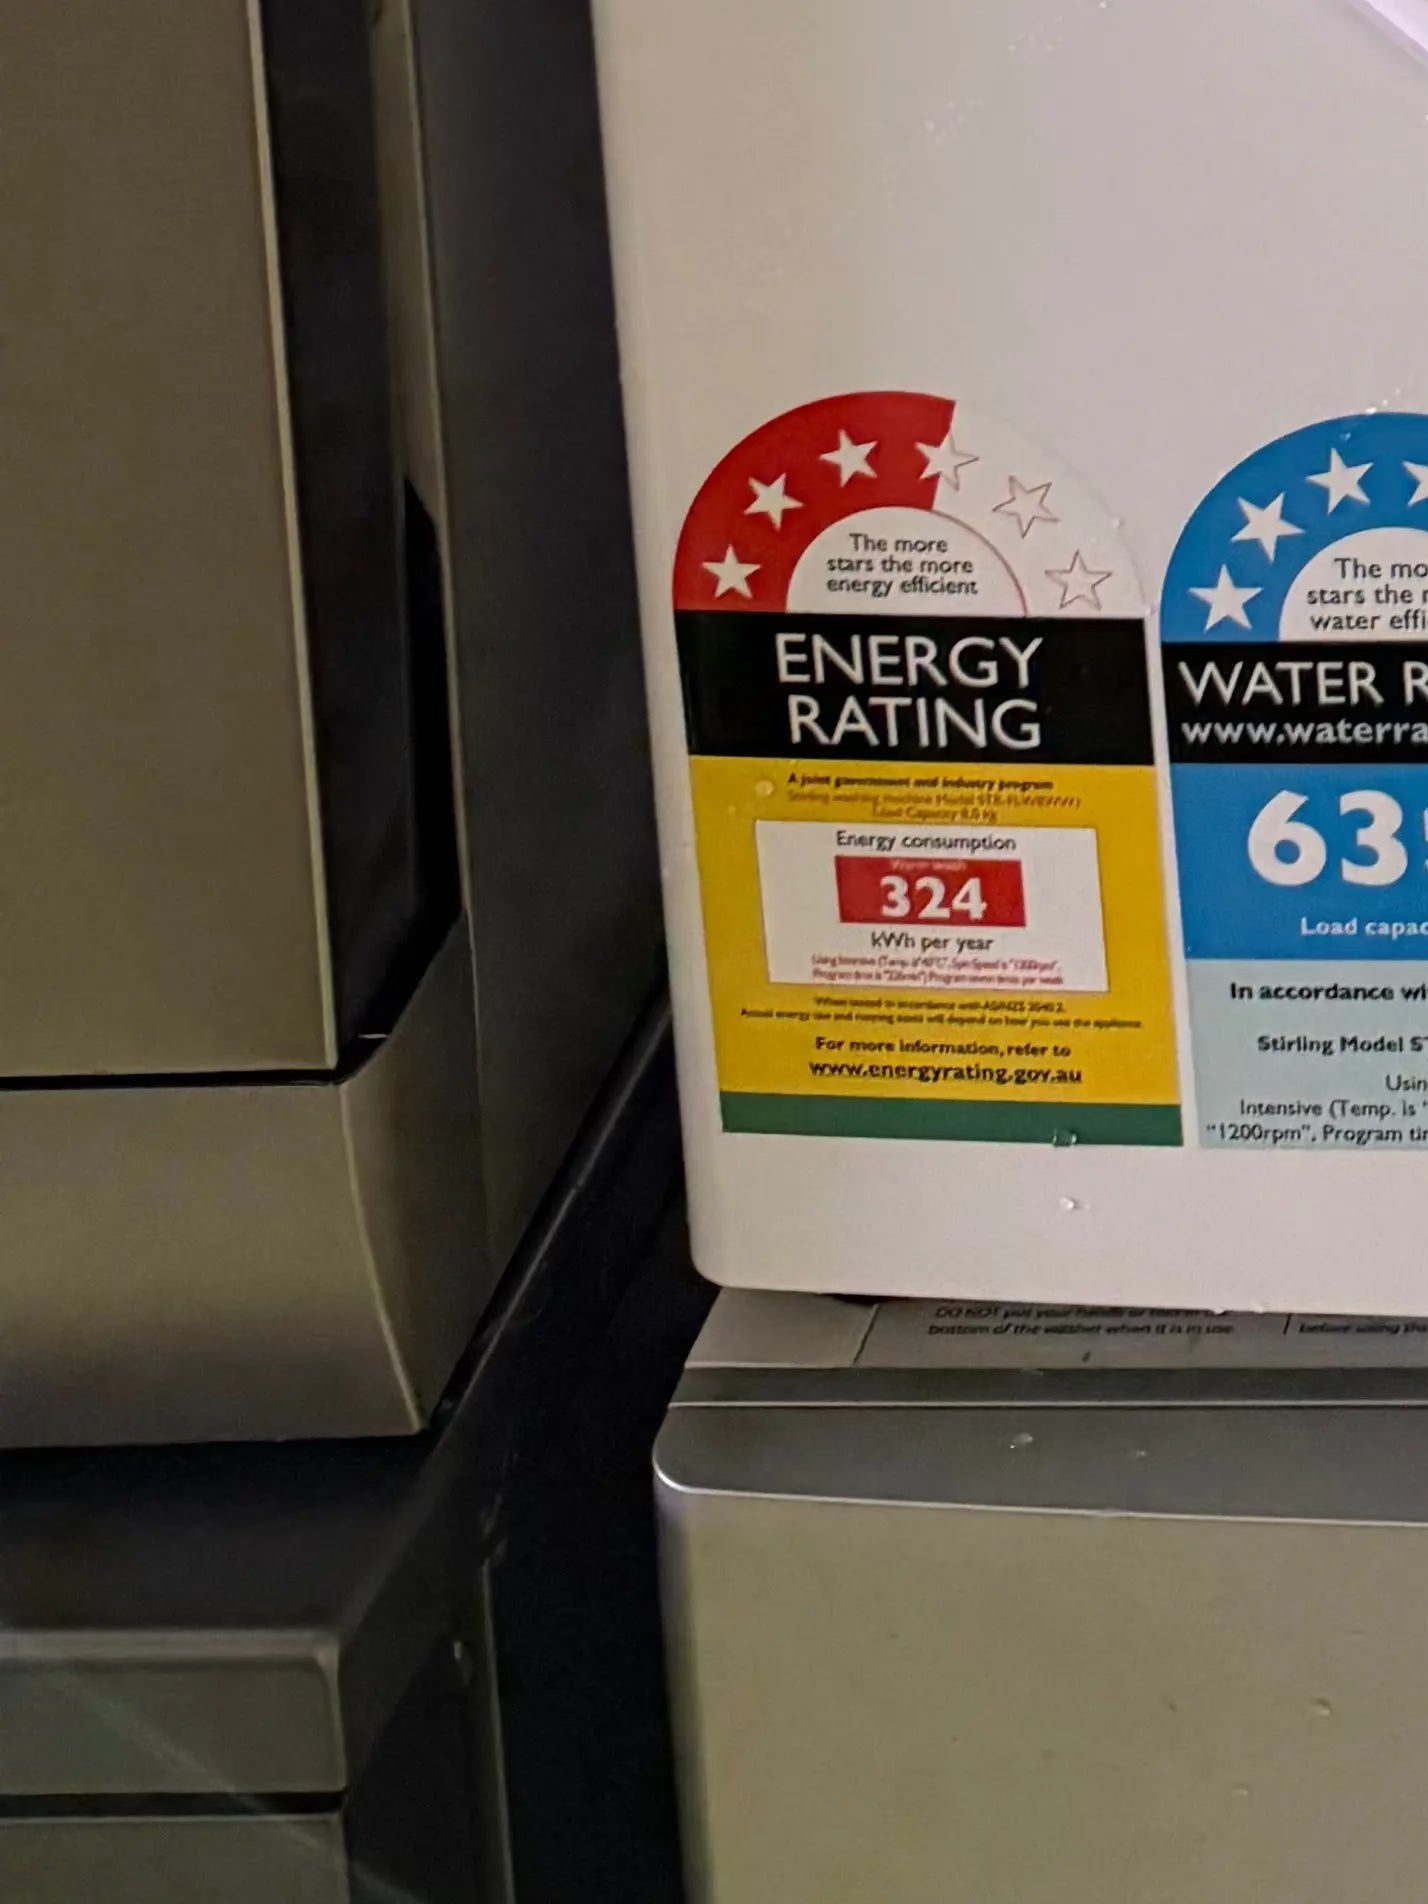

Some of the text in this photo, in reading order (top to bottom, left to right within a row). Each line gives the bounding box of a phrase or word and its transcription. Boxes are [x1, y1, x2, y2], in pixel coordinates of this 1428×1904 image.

[850, 534, 948, 553] The more
[827, 556, 973, 574] stars the more
[1334, 558, 1381, 578] The
[827, 575, 978, 597] energy efficient
[1307, 586, 1365, 604] stars
[1374, 585, 1414, 604] the
[1310, 612, 1381, 630] water
[775, 633, 1043, 688] ENERGY
[1179, 661, 1384, 706] WATER
[789, 695, 1041, 750] RATING
[836, 830, 1016, 853] Energy consumption
[1247, 790, 1409, 886] 63
[880, 875, 987, 920] 324
[1301, 918, 1357, 936] Load
[871, 932, 994, 955] kWh per year
[1231, 982, 1253, 999] In
[1259, 983, 1395, 1000] accordance
[816, 1037, 1071, 1058] For more information, refer to
[1257, 1035, 1333, 1056] Stirling
[1340, 1036, 1404, 1052] Model
[809, 1061, 1082, 1084] www.energyrating.gov.au
[1240, 1099, 1323, 1116] Intensive
[1329, 1099, 1396, 1120] (Temp.
[1402, 1100, 1416, 1116] is
[1323, 1125, 1403, 1145] Program
